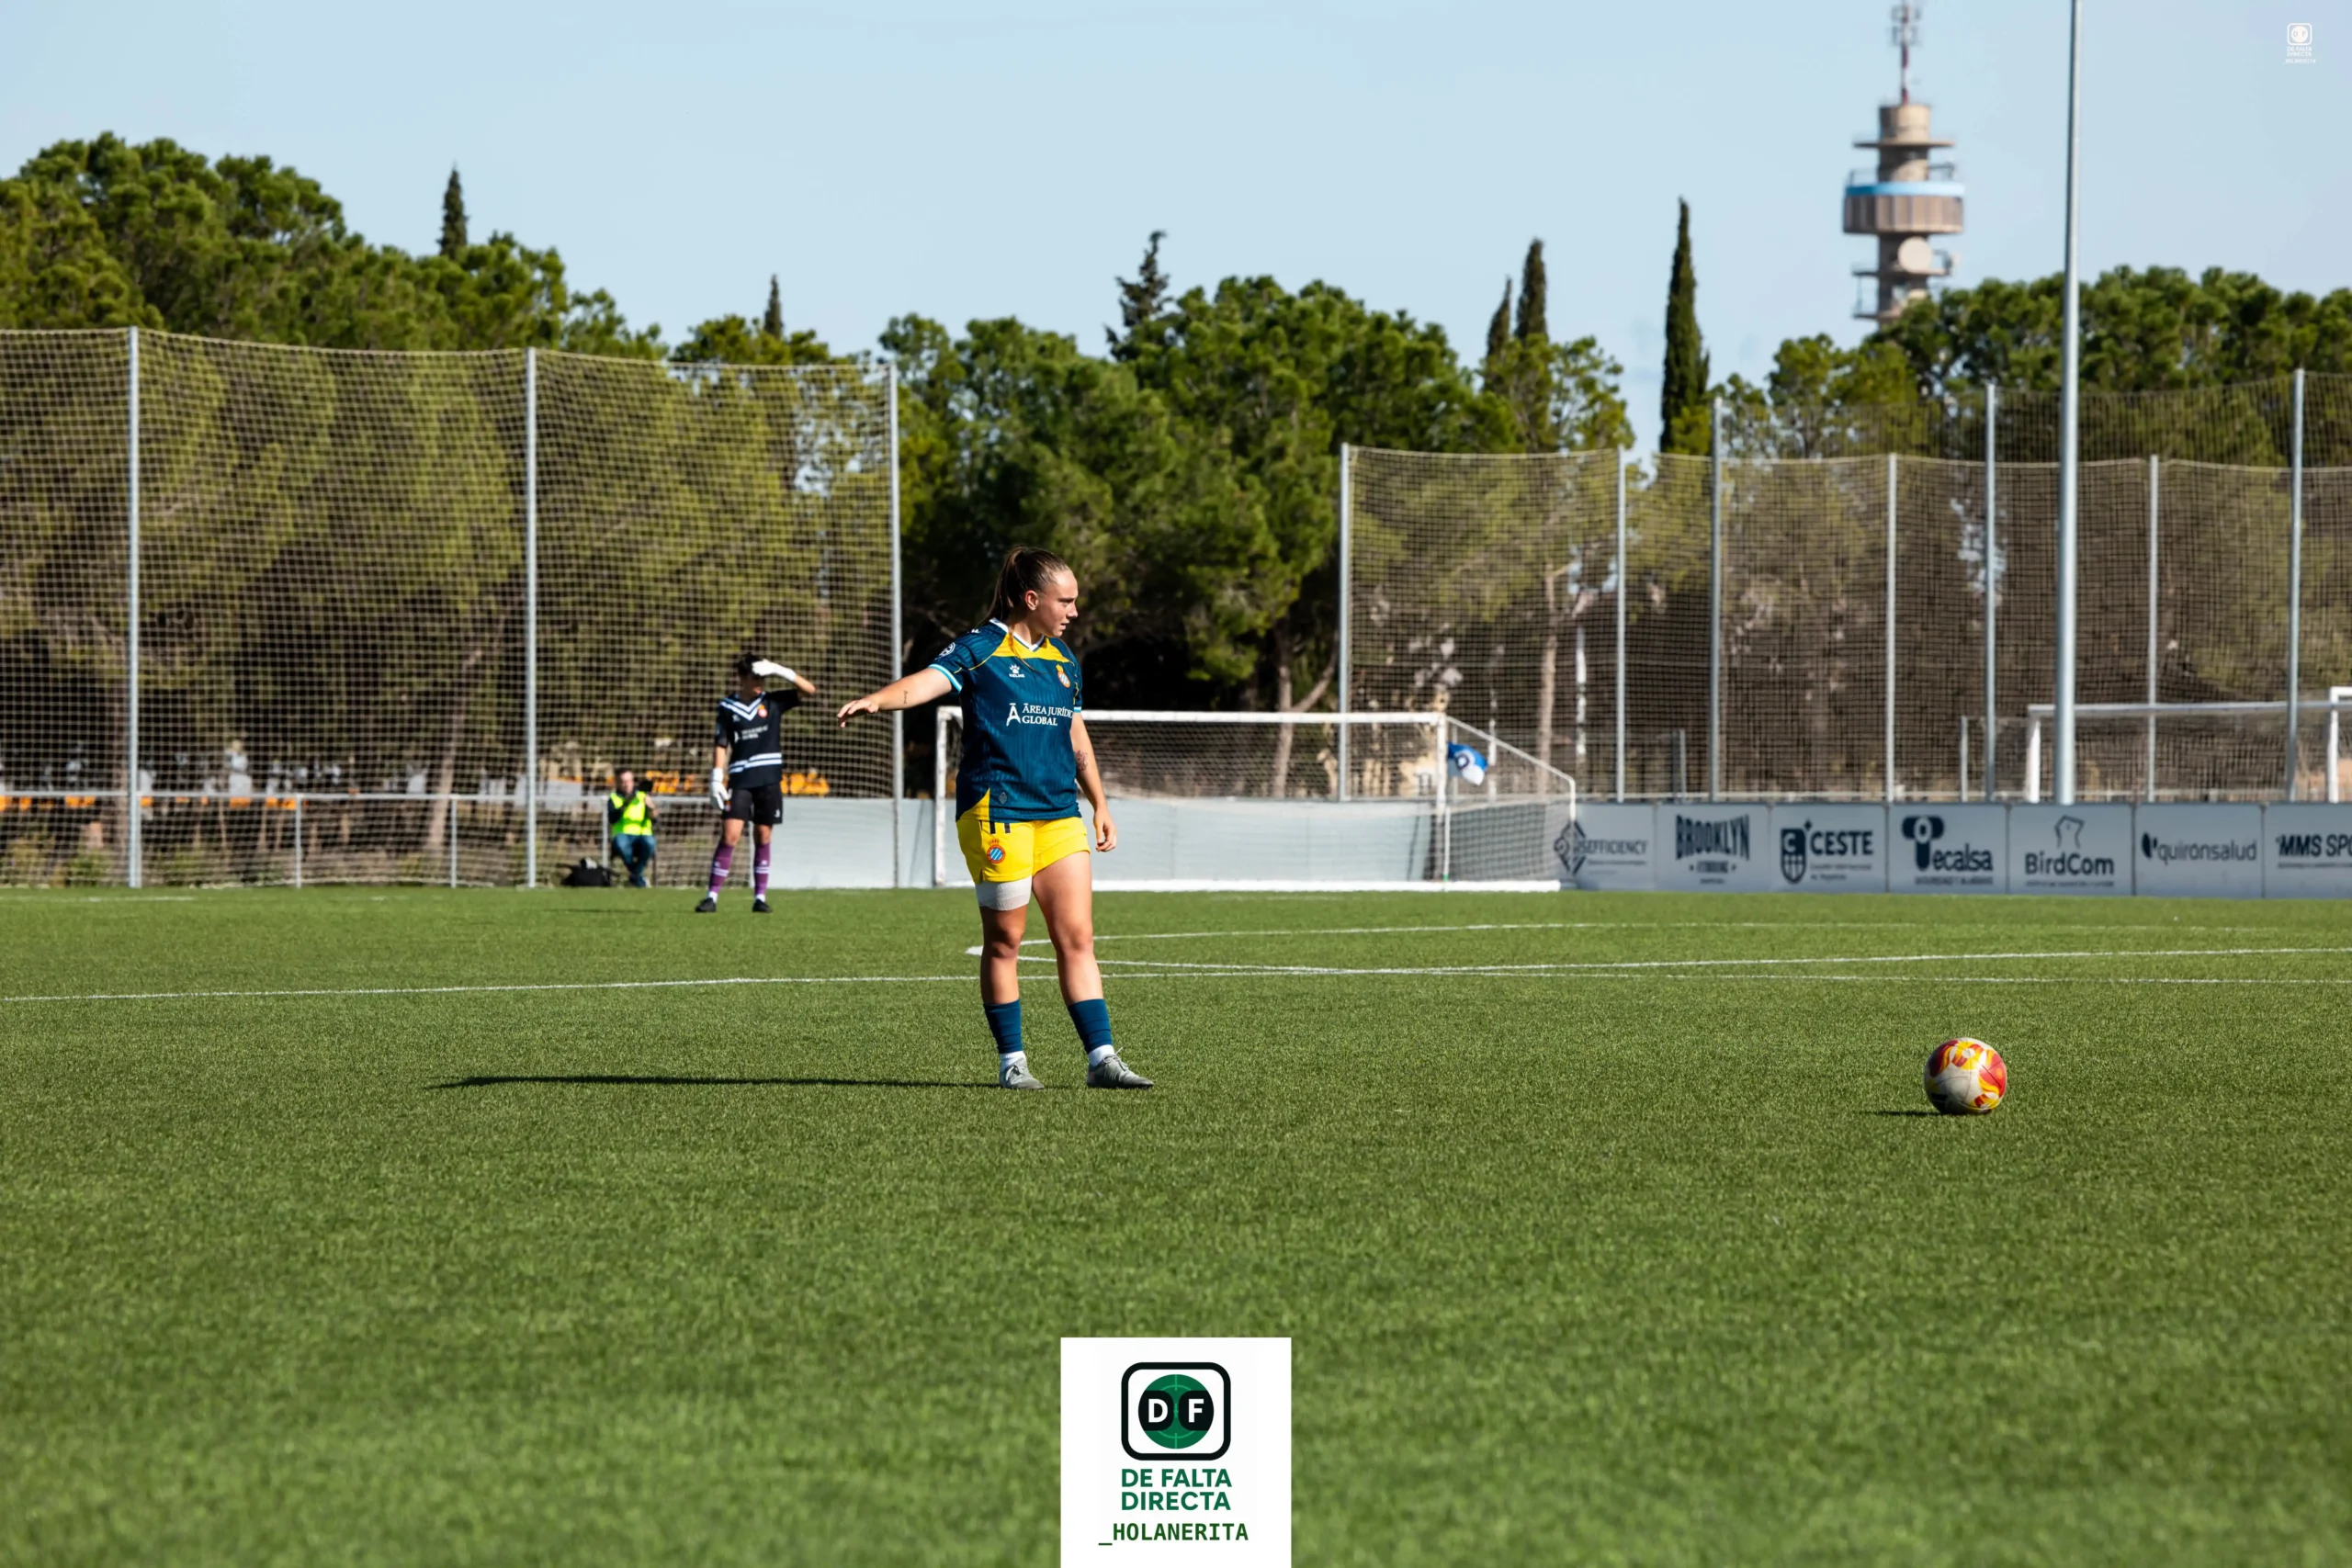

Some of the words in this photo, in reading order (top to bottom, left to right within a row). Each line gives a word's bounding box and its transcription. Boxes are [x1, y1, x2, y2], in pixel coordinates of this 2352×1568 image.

[1022, 716, 1057, 726] GLOBAL
[1676, 814, 1749, 861] BROOKLYN
[1810, 830, 1874, 856] CESTE
[2278, 834, 2323, 857] MMS
[2025, 851, 2114, 875] BirdCom
